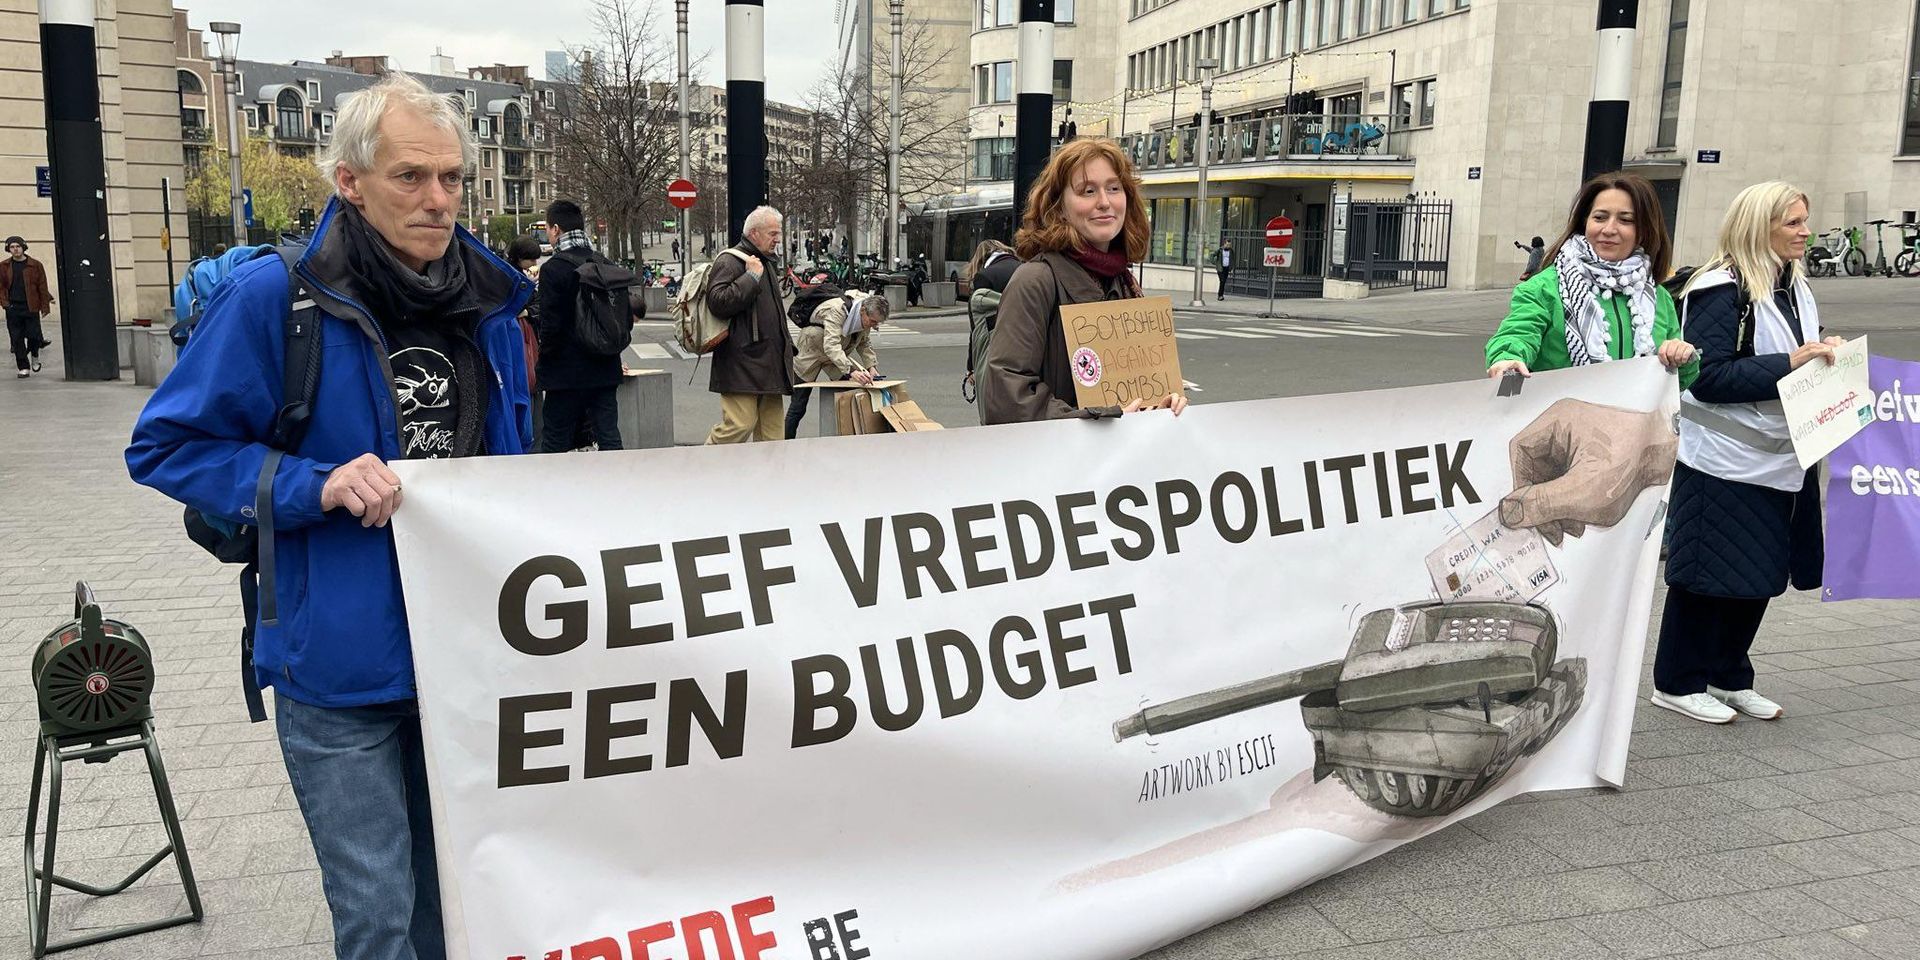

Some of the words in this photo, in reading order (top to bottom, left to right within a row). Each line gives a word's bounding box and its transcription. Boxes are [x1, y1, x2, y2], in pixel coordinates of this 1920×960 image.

[1071, 308, 1173, 346] BOMBSHELLS
[1101, 372, 1171, 407] BOMBS!
[497, 528, 796, 657] GEEF
[820, 439, 1482, 609] VREDESPOLITIEK
[1448, 544, 1478, 567] CREDIT
[1480, 528, 1503, 547] WAR
[1517, 541, 1536, 558] 9010
[1530, 568, 1549, 586] VISA
[497, 669, 748, 789] EEN
[791, 593, 1138, 750] BUDGET
[1138, 751, 1214, 803] ARTWORK
[1216, 746, 1233, 783] BY
[1236, 734, 1276, 775] ESCIF
[803, 908, 871, 960] BE
